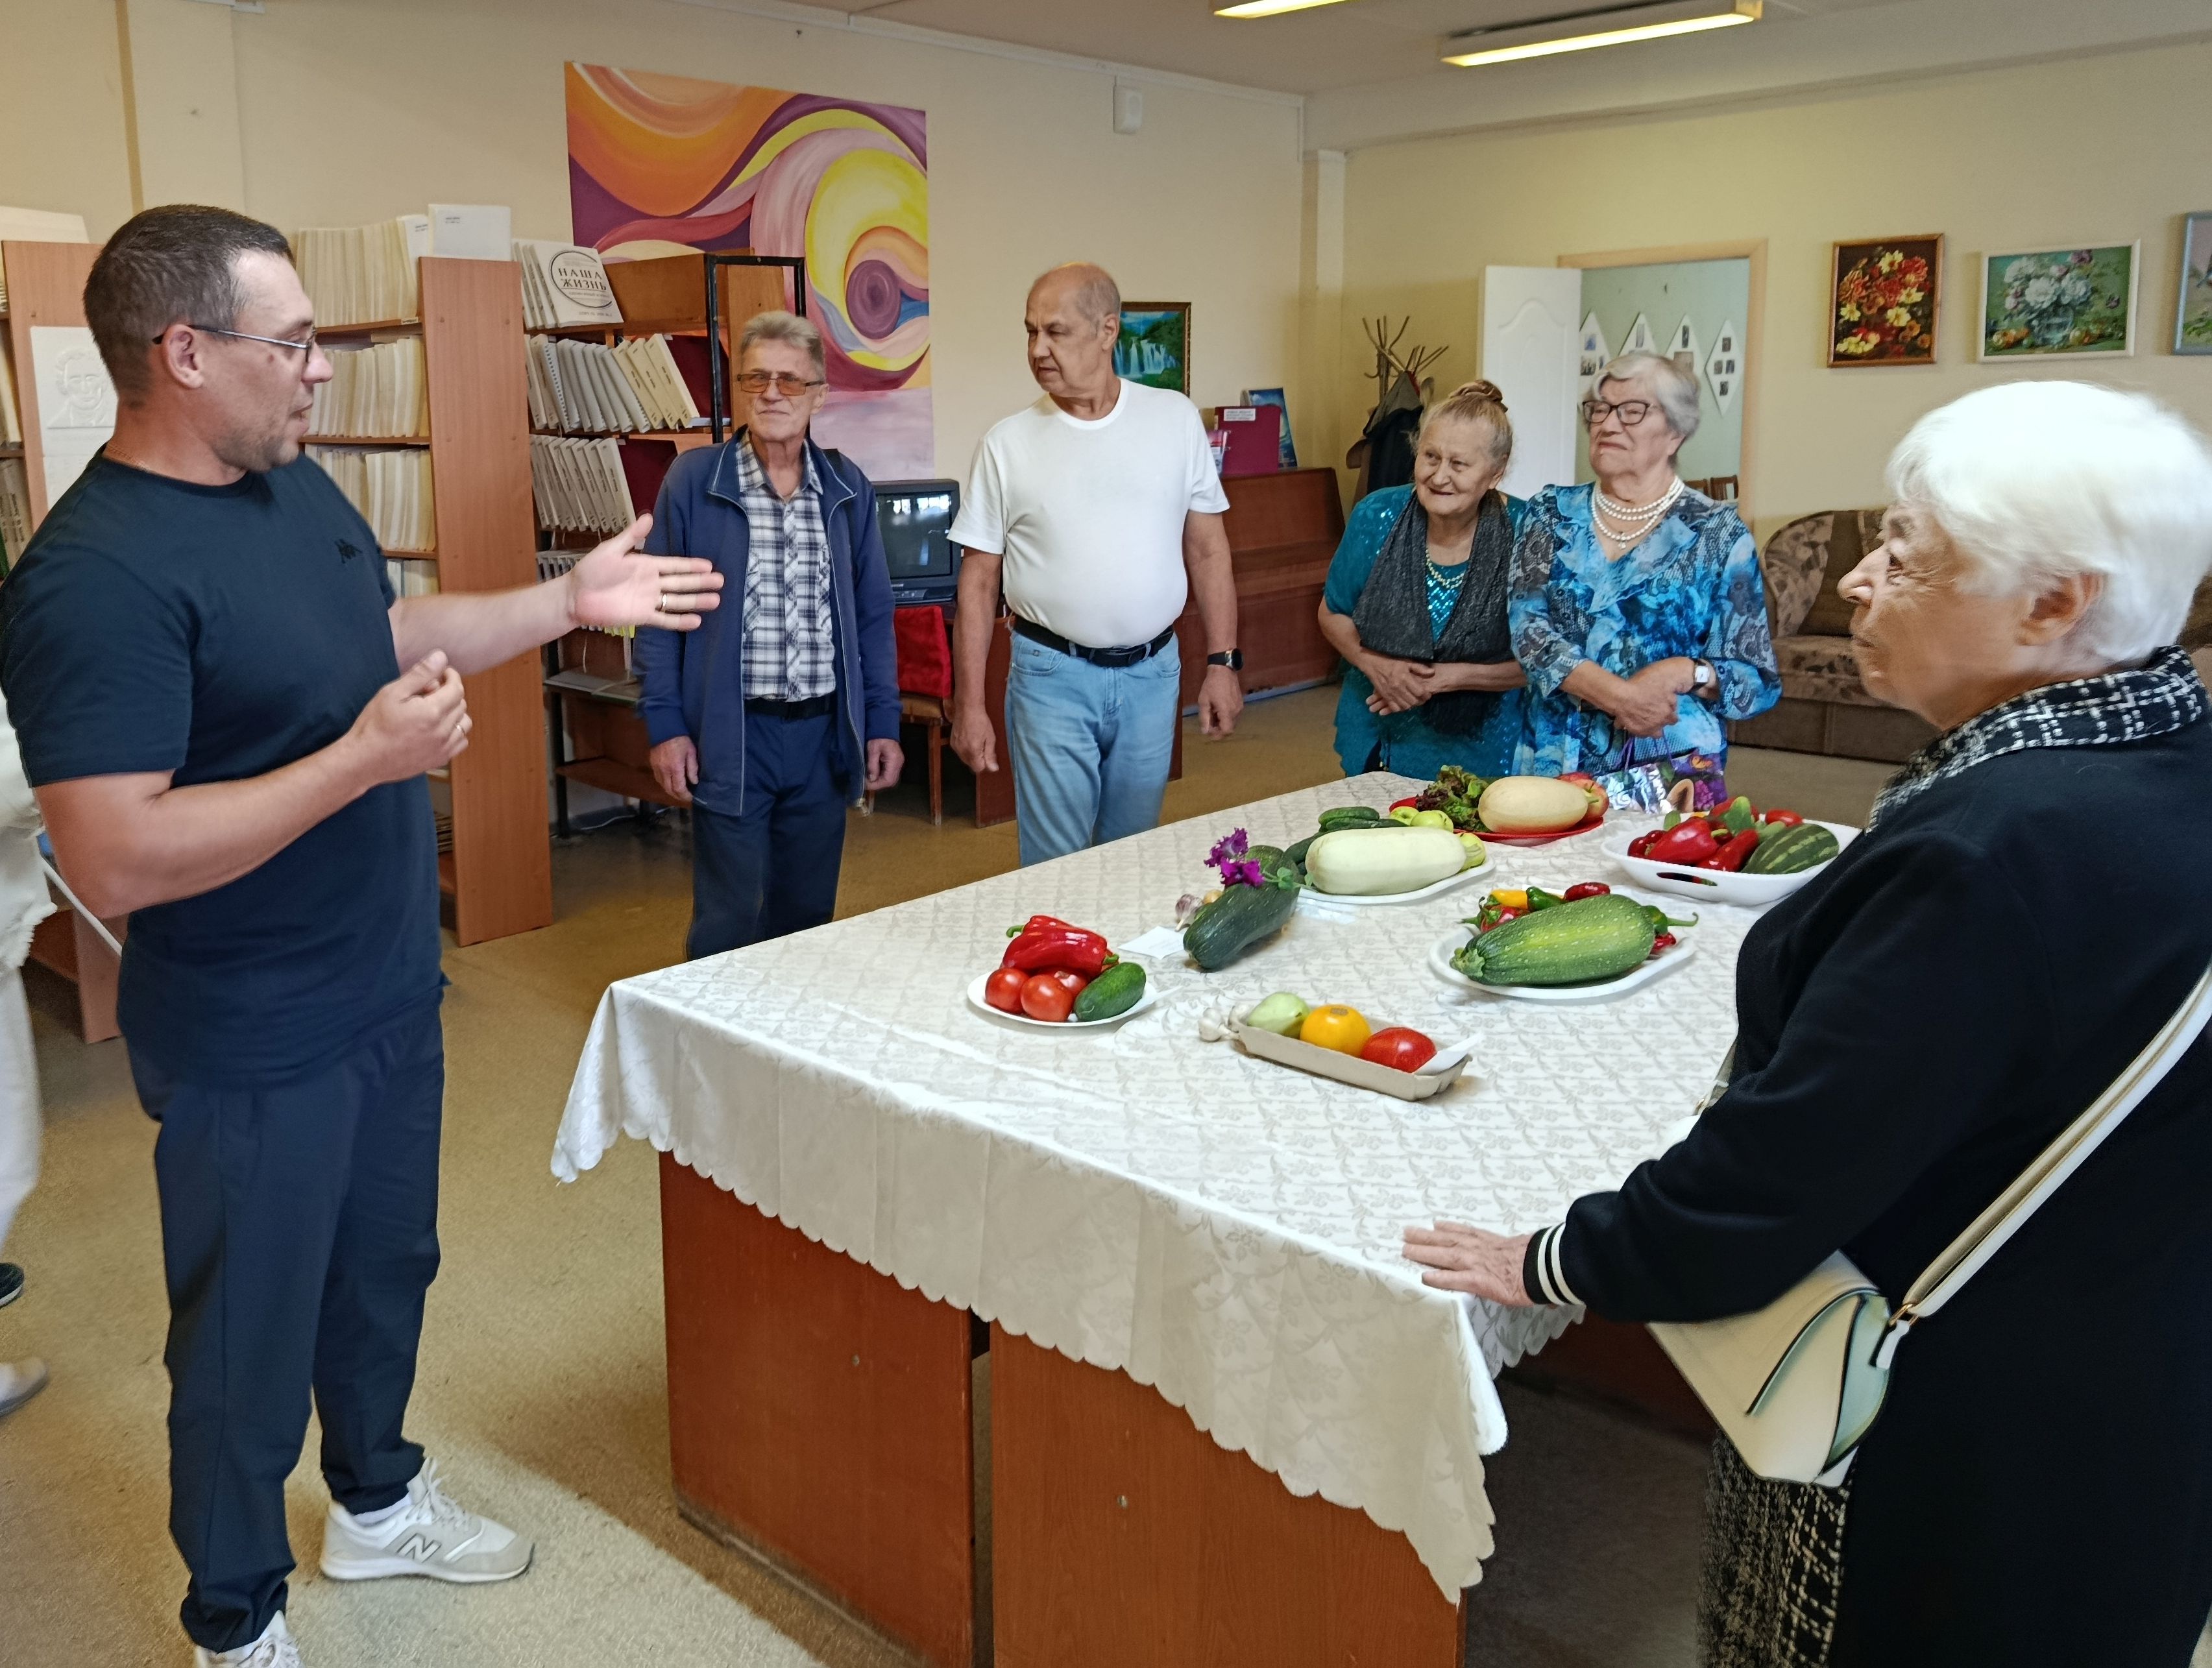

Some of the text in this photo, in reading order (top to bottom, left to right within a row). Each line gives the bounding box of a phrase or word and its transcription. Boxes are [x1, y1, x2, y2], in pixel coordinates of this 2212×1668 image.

[558, 268, 602, 280] НАША
[561, 278, 607, 291] ЖИЗНЬ
[395, 1532, 442, 1564] N
